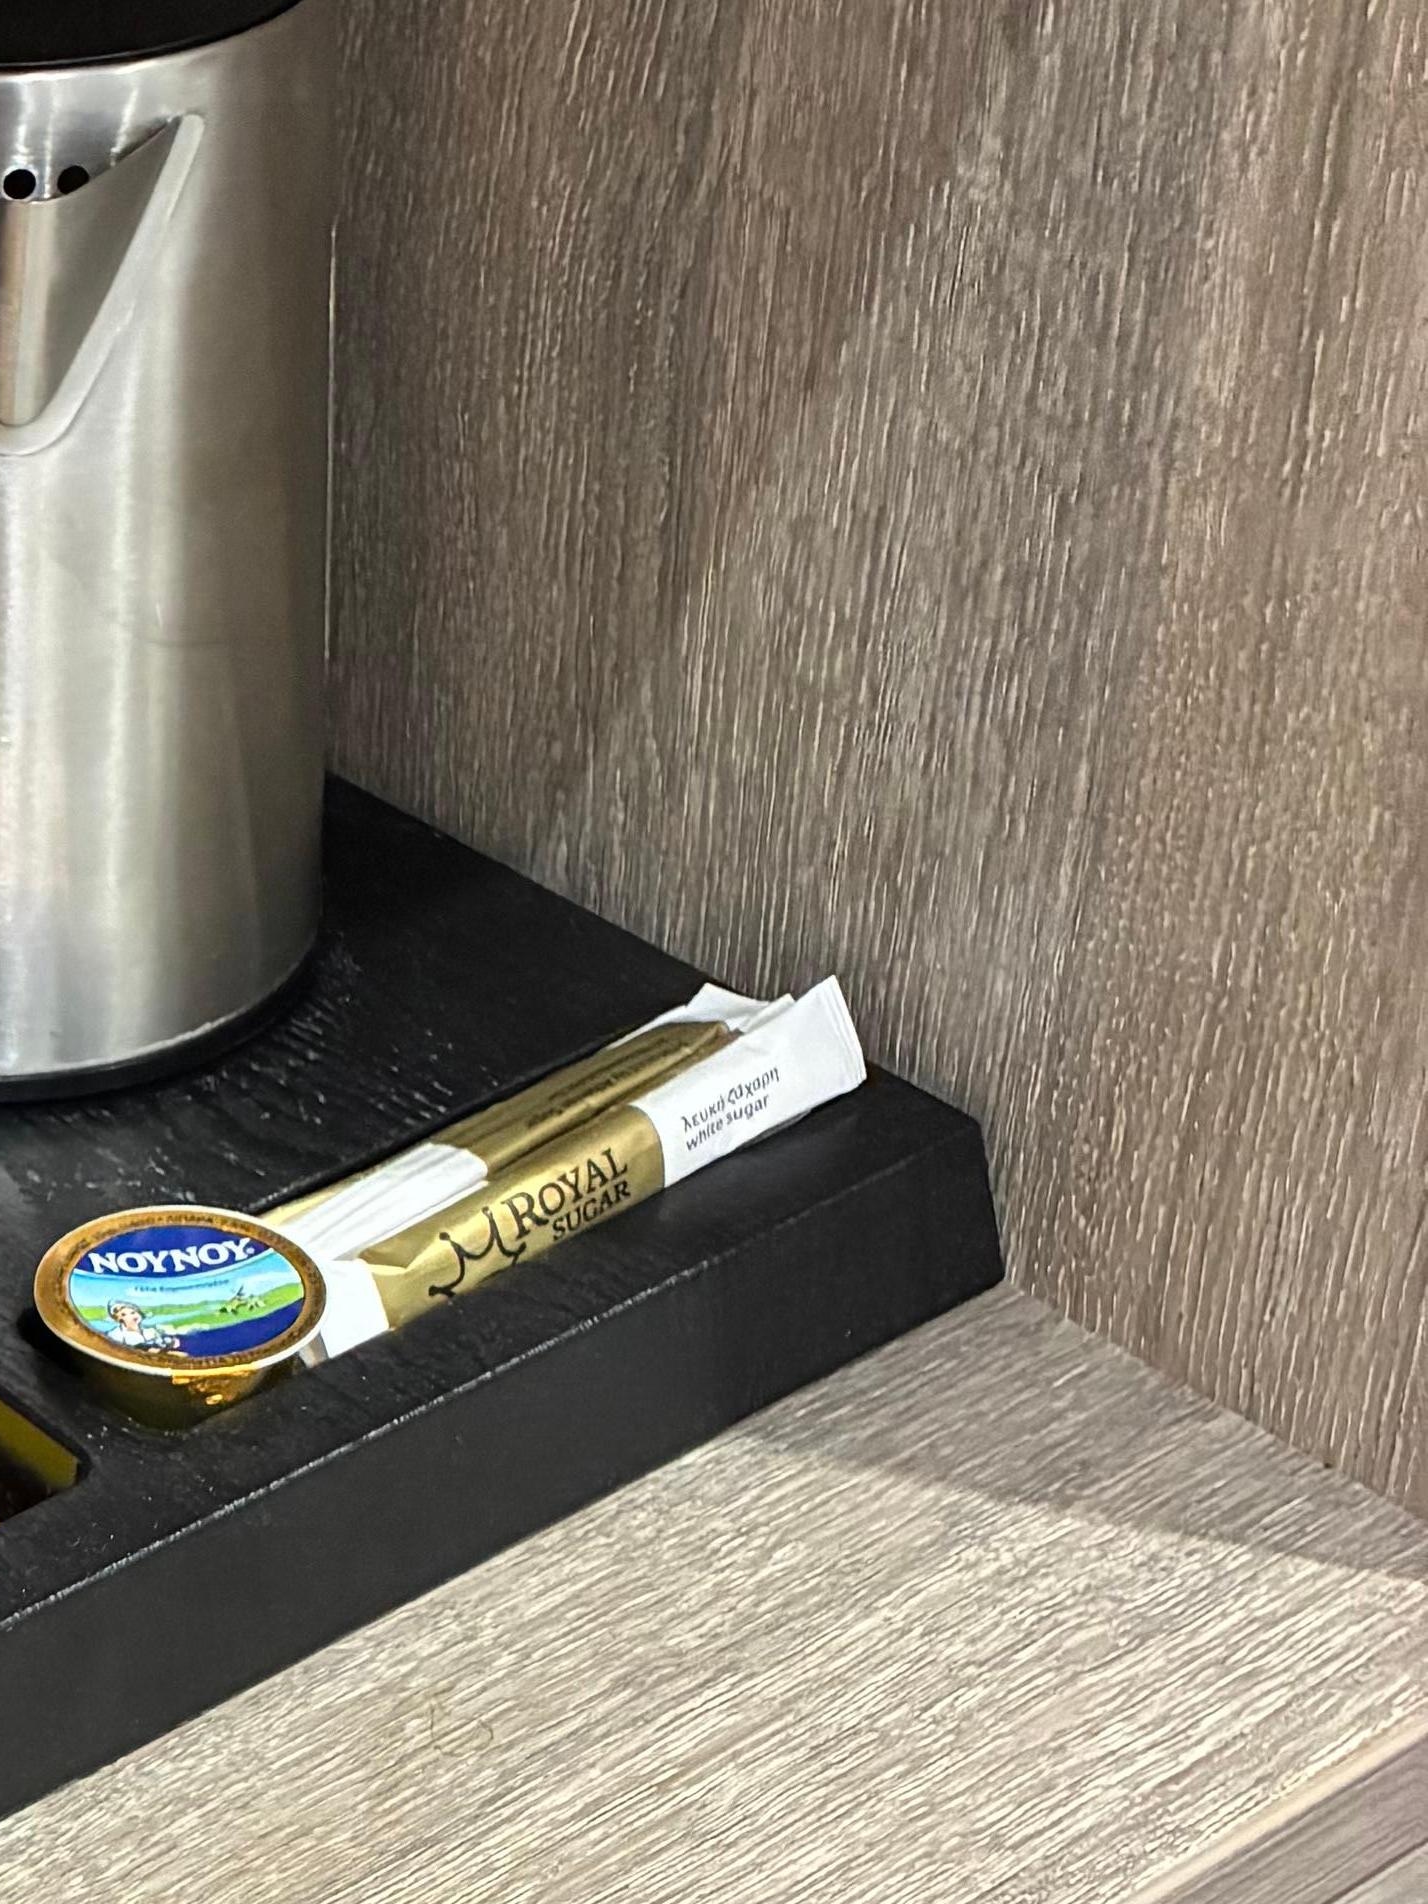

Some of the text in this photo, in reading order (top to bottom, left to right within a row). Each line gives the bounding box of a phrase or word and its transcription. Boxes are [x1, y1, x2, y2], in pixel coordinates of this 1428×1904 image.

[686, 1094, 770, 1151] white sugar
[501, 1148, 628, 1238] ROYAL
[552, 1179, 632, 1243] SUGAR
